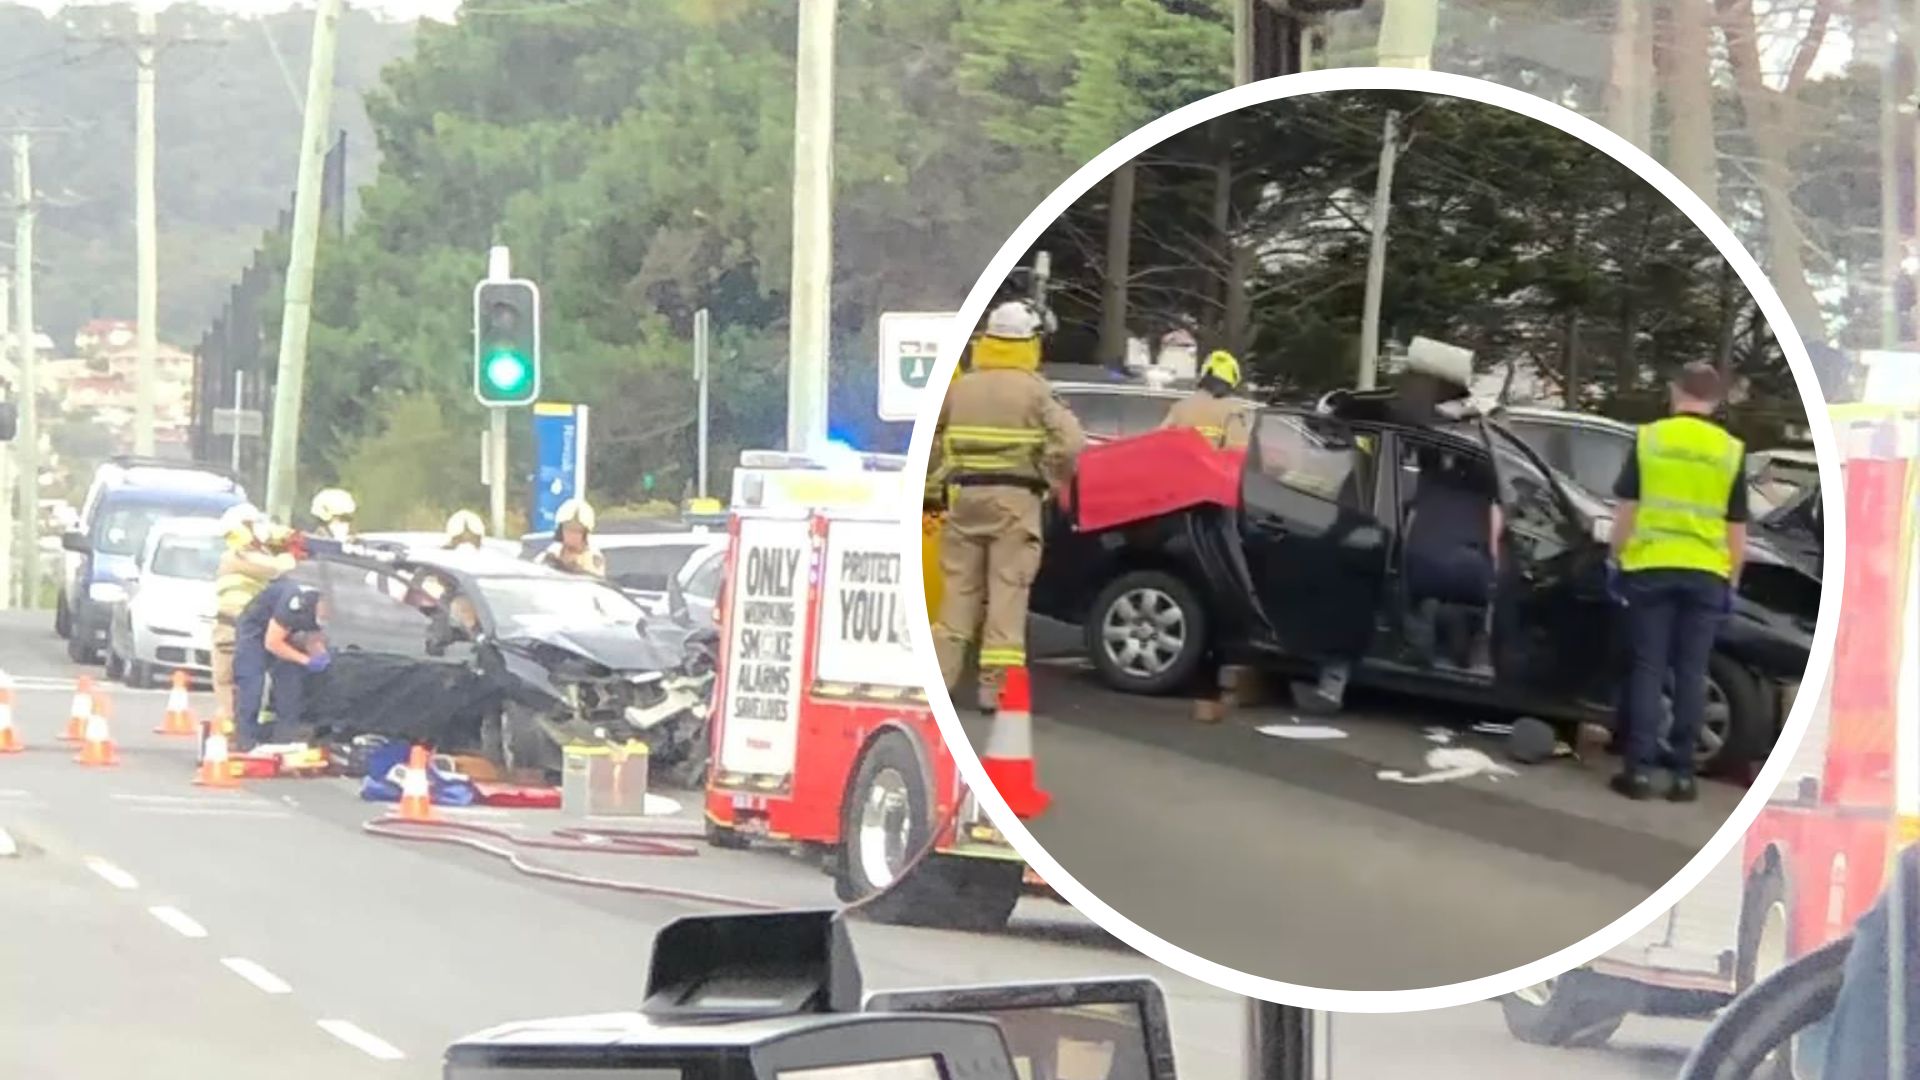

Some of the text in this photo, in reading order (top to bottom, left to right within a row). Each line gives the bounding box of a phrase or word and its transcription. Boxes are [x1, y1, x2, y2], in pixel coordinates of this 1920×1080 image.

[746, 546, 800, 596] ONLY
[841, 550, 901, 584] PROTECT
[840, 589, 900, 643] YOU L
[737, 664, 790, 695] ALARMS
